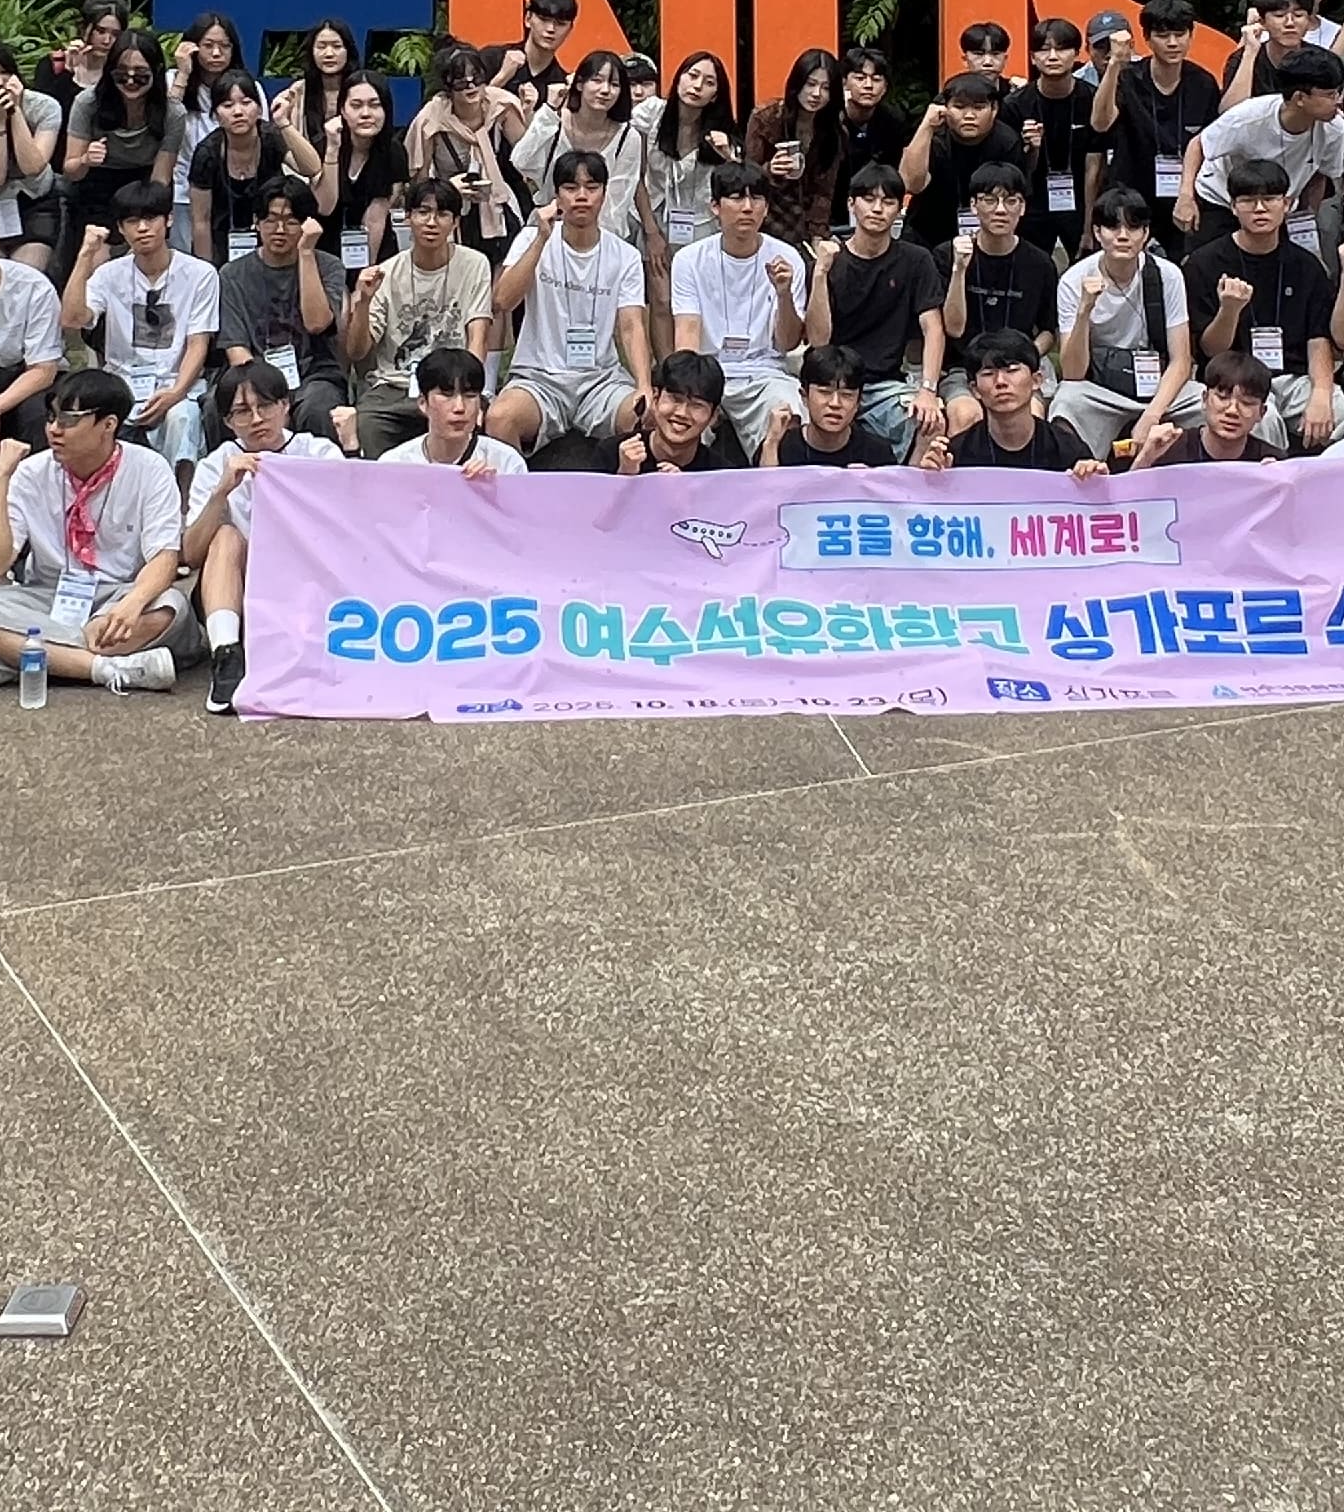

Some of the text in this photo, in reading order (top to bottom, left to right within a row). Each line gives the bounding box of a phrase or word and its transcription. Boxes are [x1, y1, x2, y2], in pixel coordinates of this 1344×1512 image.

[817, 511, 1140, 558] 꿈을 향해, 세계로!
[328, 597, 541, 663] 2025
[561, 596, 1030, 666] 여수석유화학고
[1046, 589, 1308, 660] 싱가포르
